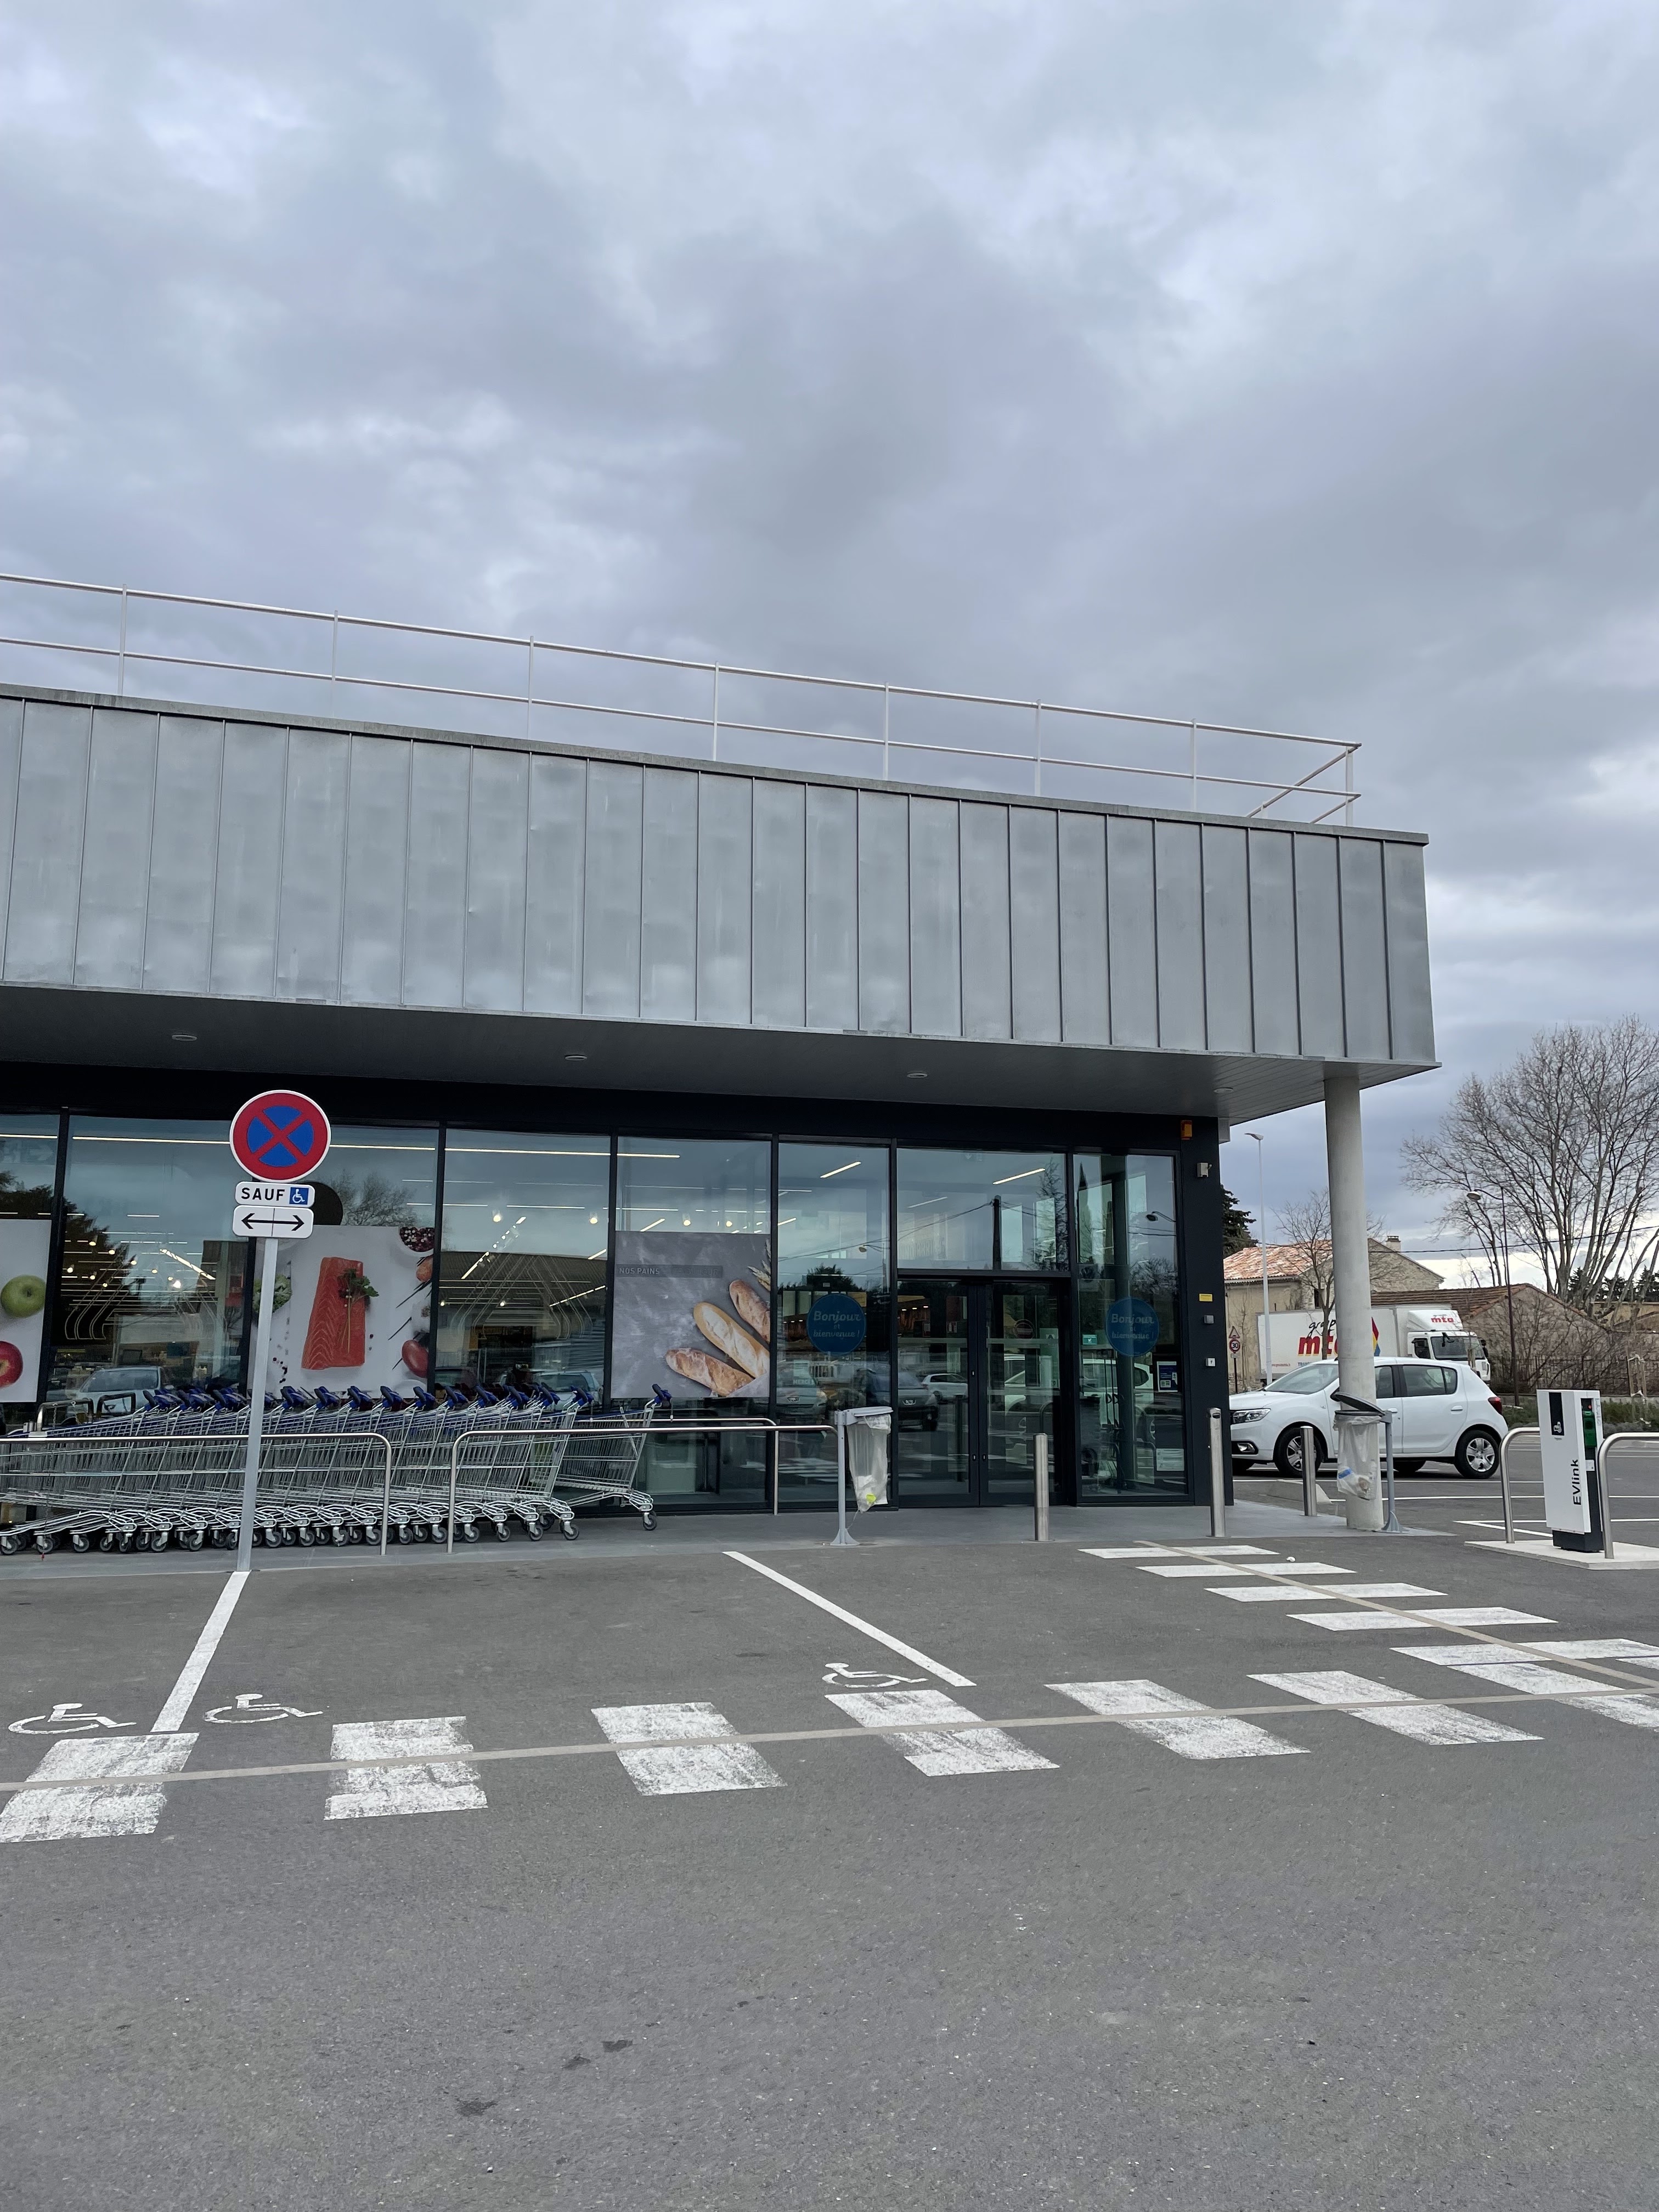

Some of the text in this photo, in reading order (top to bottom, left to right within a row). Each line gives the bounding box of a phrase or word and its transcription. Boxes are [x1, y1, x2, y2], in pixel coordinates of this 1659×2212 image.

[241, 1187, 285, 1201] SAUF
[813, 1311, 862, 1324] Bonjour
[1111, 1313, 1155, 1325] Bonjour
[813, 1329, 855, 1338] bienvenue
[1570, 1458, 1582, 1505] EVlink
